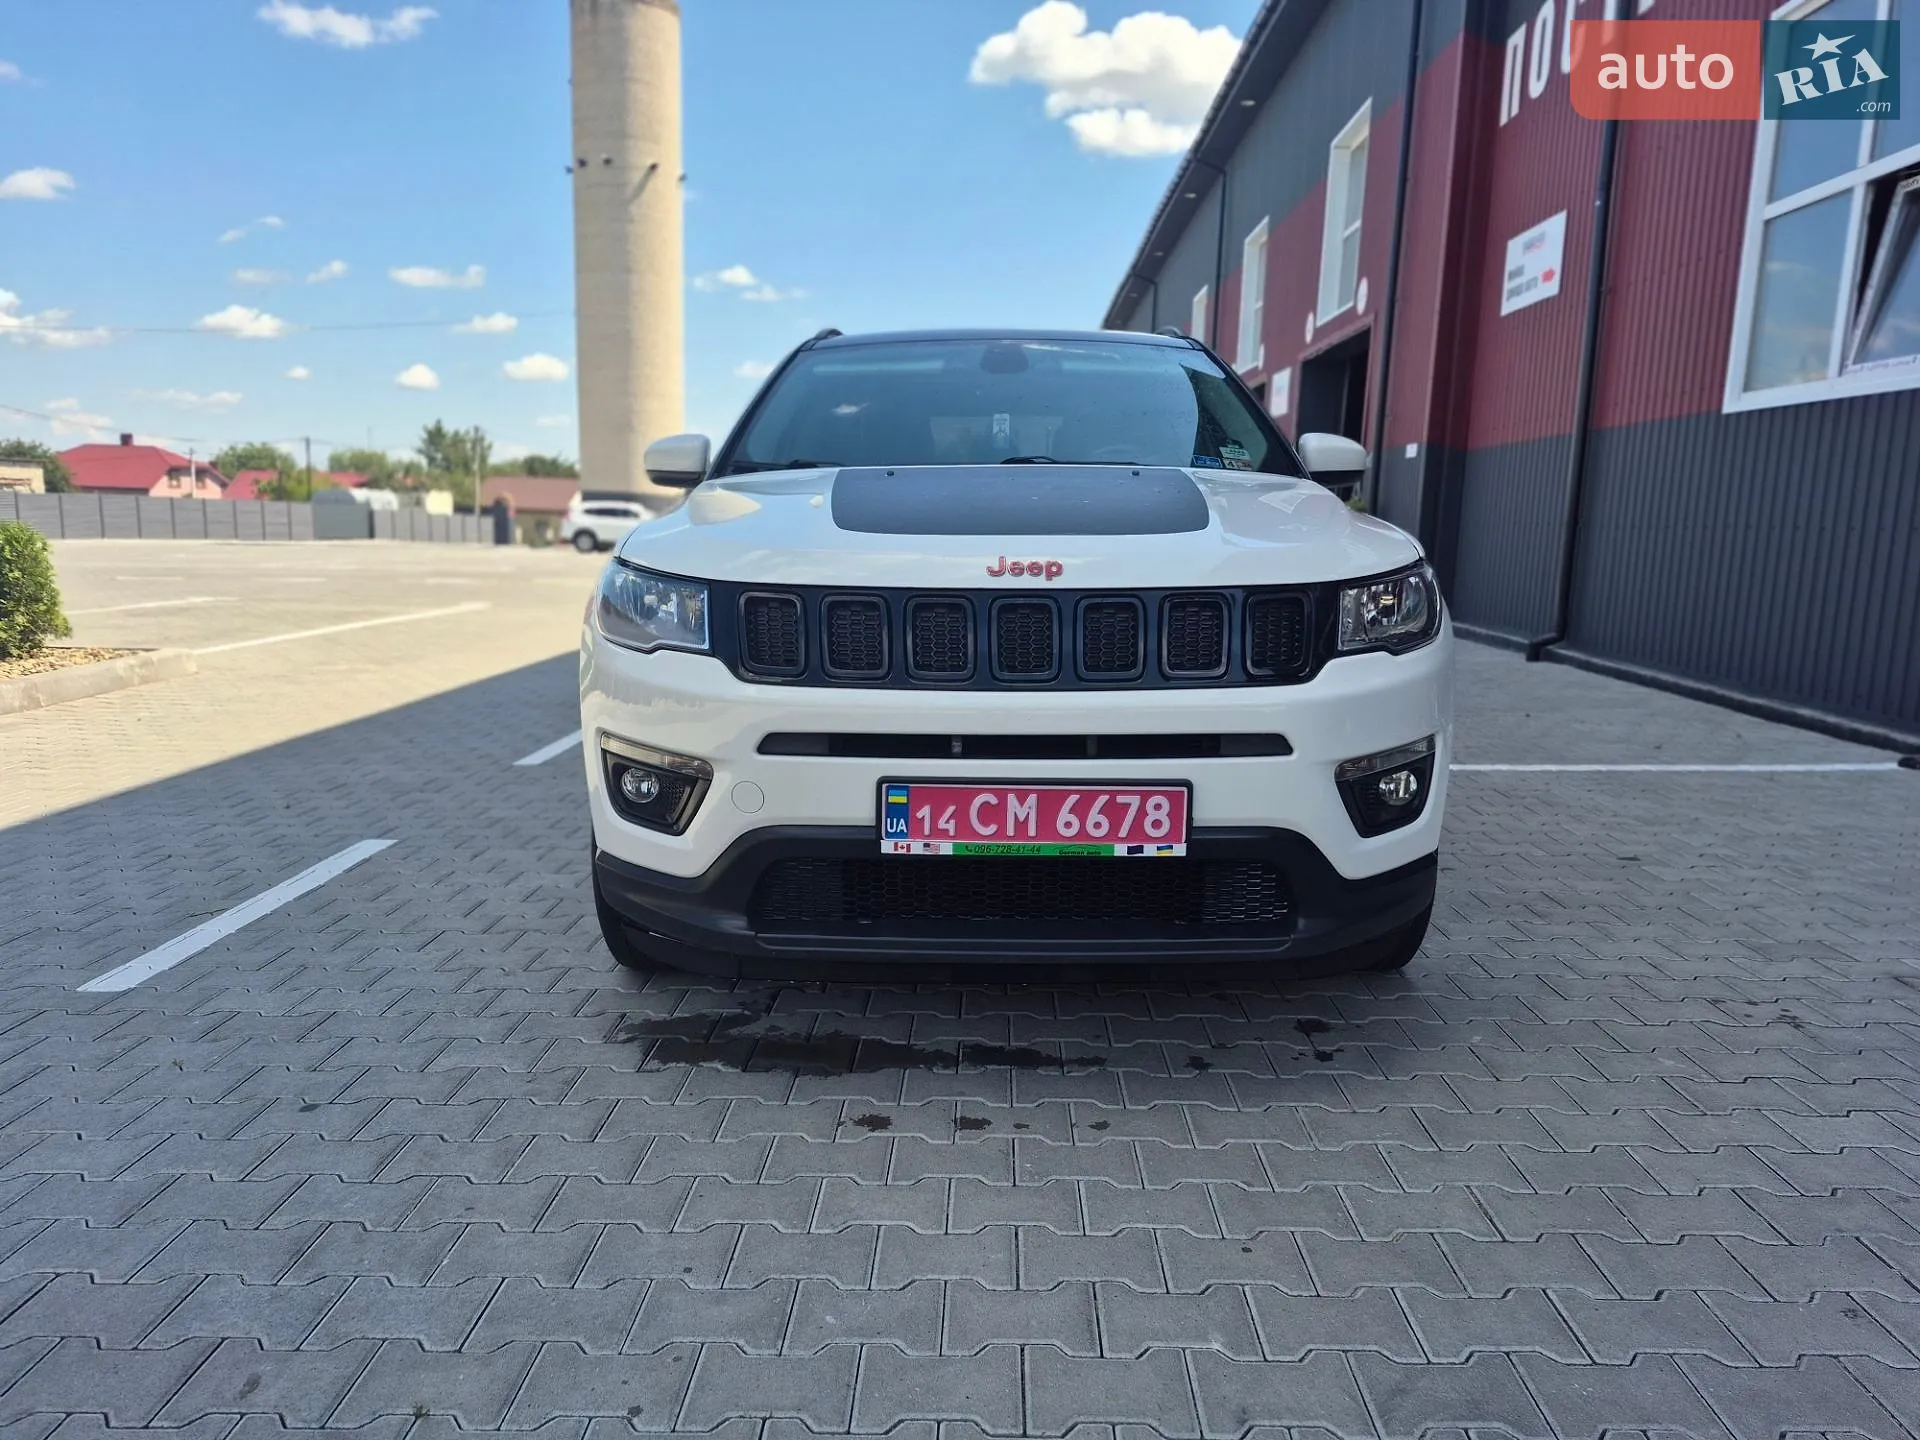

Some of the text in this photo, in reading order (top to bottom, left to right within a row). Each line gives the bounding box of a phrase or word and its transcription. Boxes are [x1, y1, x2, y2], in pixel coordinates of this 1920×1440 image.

[985, 555, 1064, 581] Jeep
[886, 793, 1172, 839] UA 14 CM 6678
